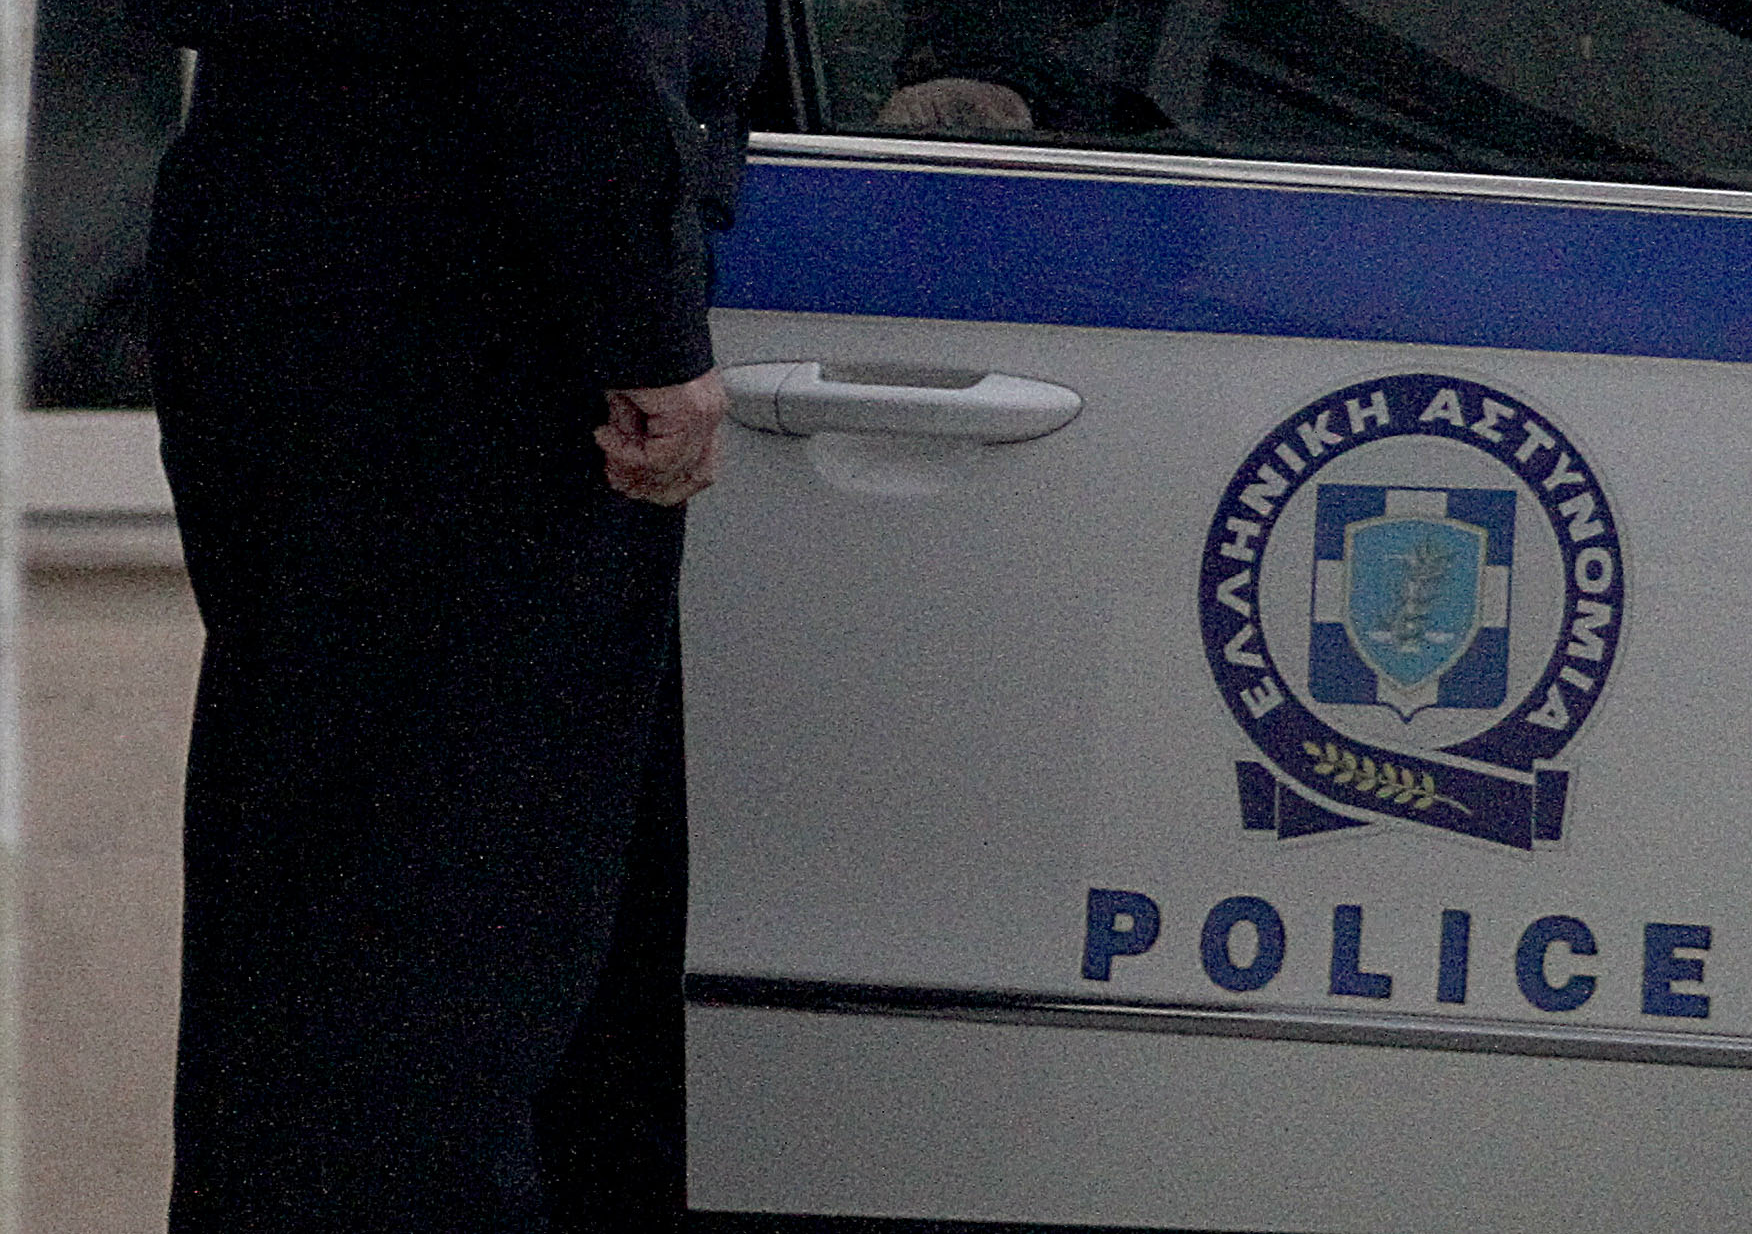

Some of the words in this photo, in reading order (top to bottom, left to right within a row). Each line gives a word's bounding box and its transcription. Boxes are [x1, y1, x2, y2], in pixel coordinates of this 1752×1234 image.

[1216, 389, 1390, 720] ΕΛΛΗΝΙΚΗ
[1419, 386, 1614, 732] ΑΣΤΥΝΟΜΙΑ
[1080, 887, 1712, 1019] POLICE
